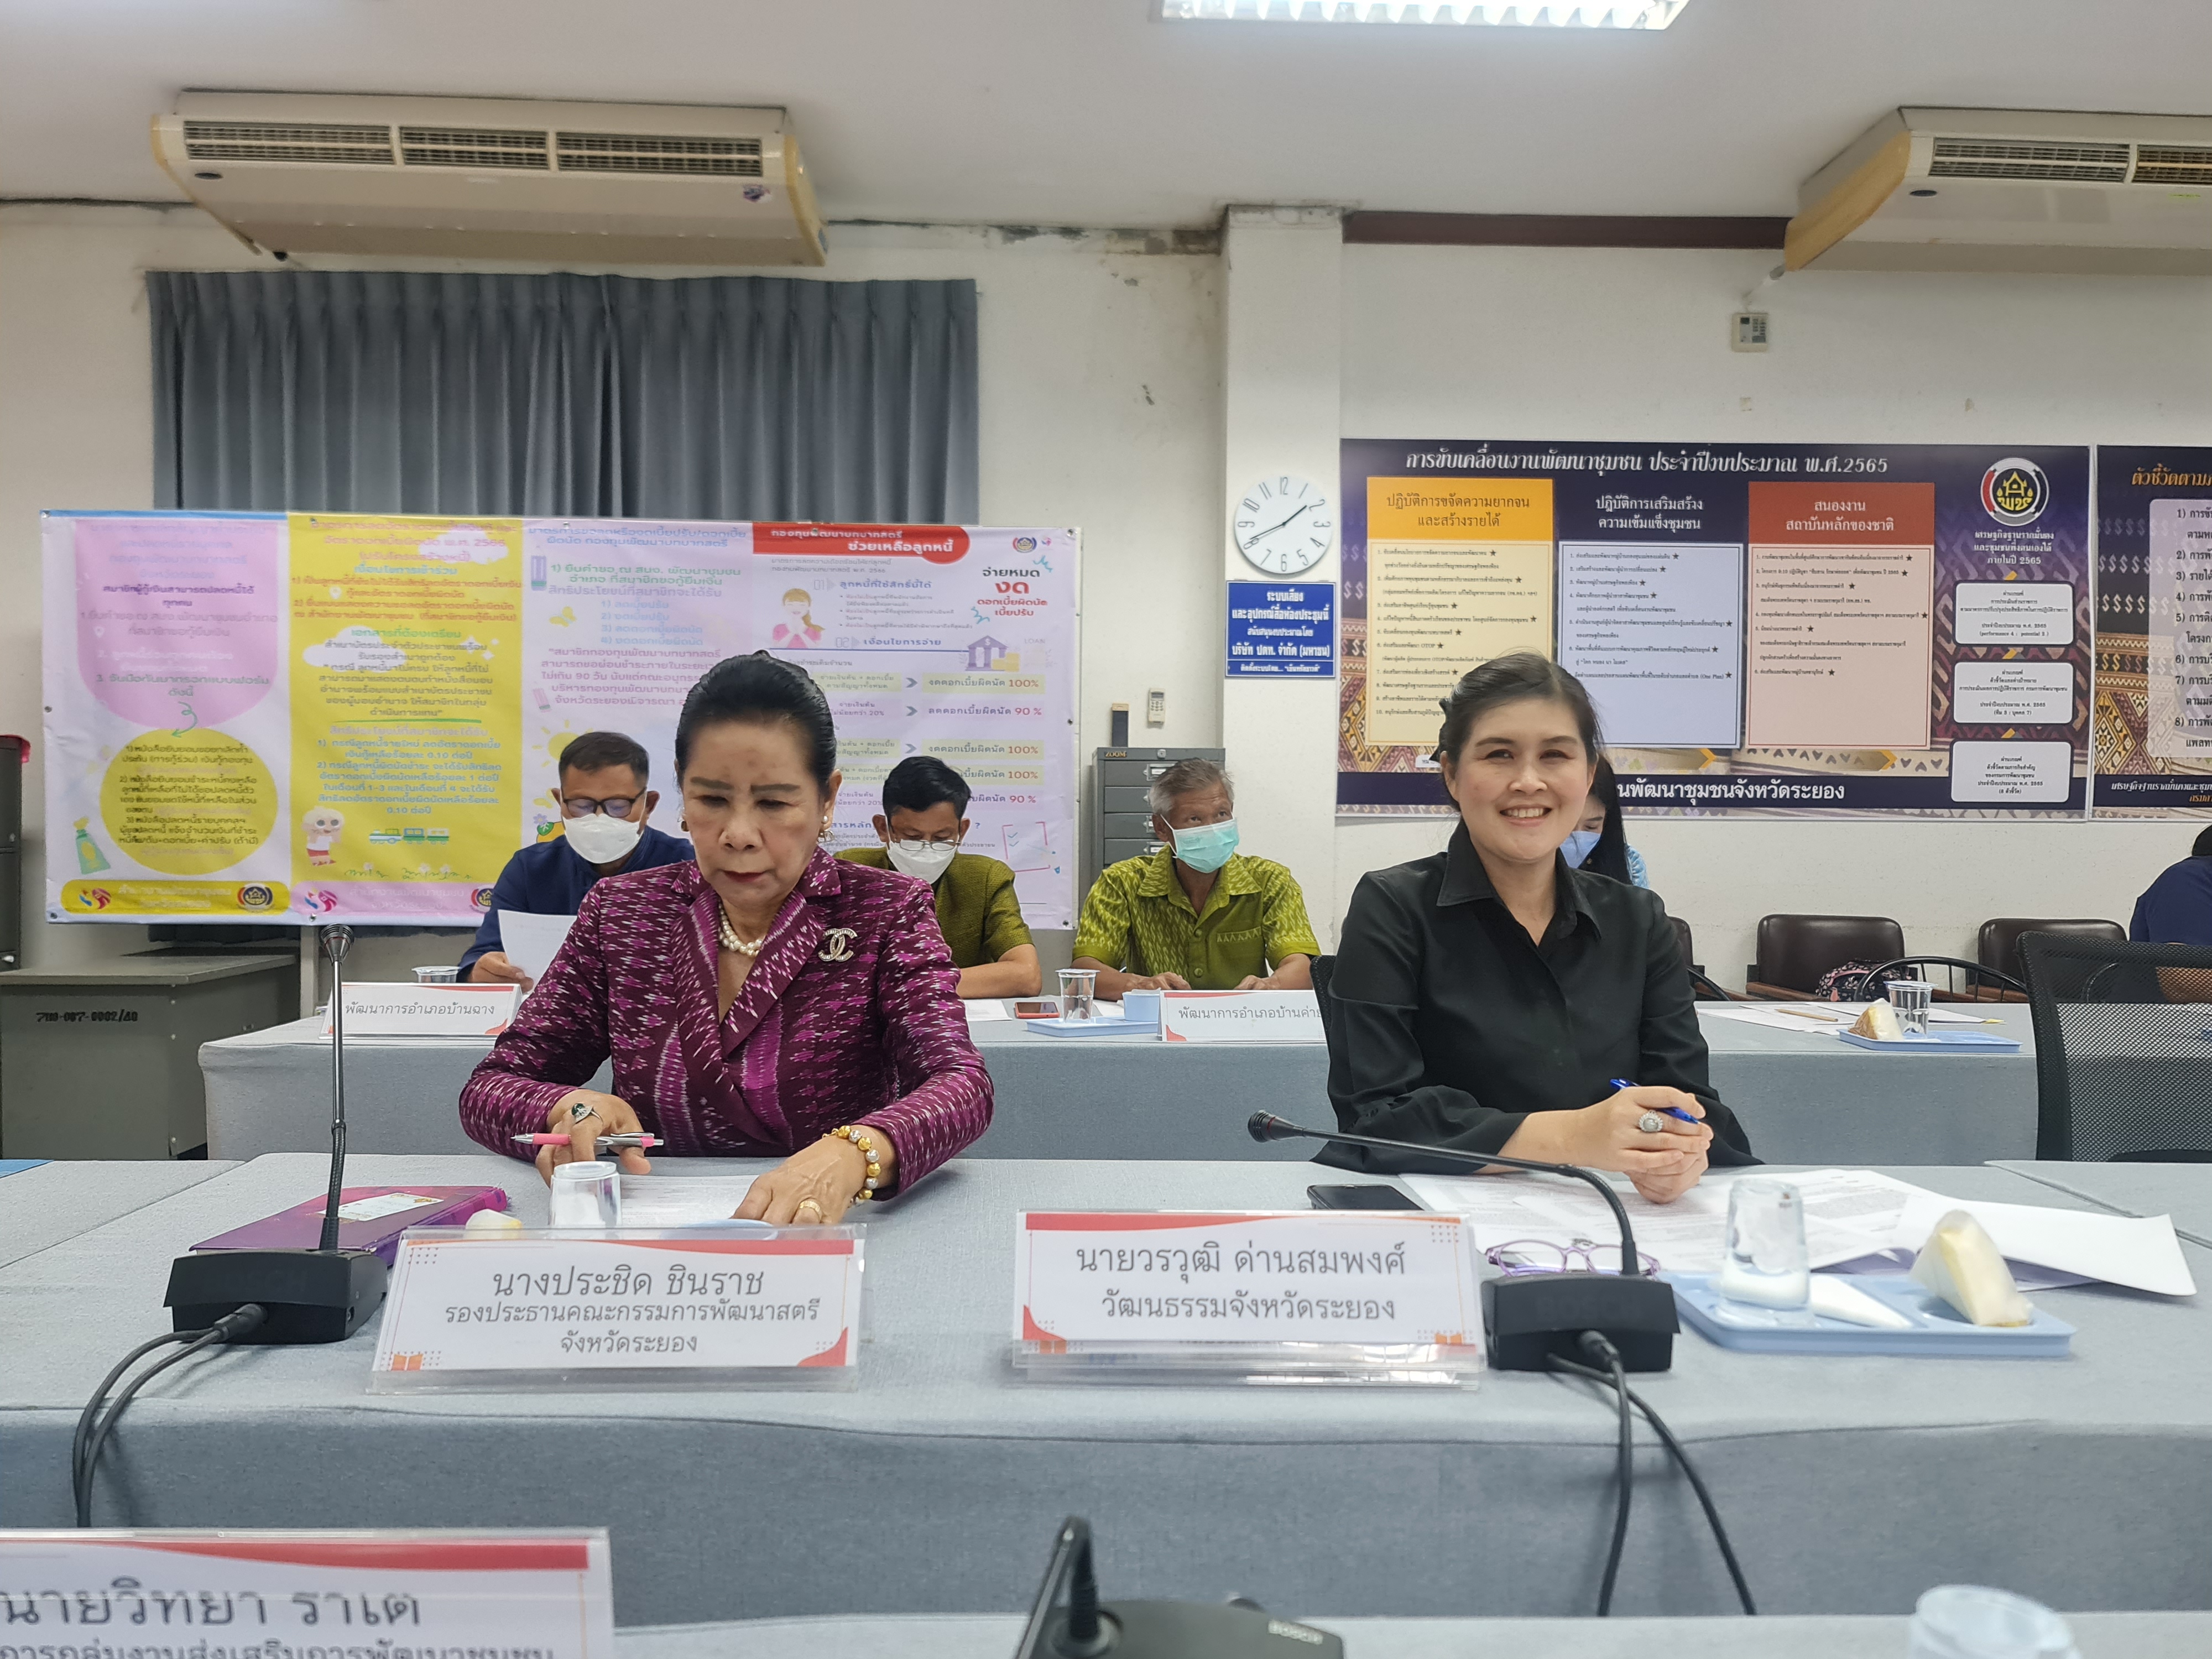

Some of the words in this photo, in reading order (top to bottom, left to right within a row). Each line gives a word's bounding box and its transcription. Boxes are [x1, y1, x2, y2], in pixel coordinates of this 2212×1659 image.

[1406, 444, 1643, 477] การขับเคลื่อนงานพัฒนาชุมชน
[1650, 449, 1798, 472] ประจำปีงบประมาณ
[1804, 455, 1888, 473] พ.ศ.2565
[1280, 477, 1288, 495] 12
[1243, 498, 1260, 513] 10
[1309, 499, 1325, 512] 2
[1387, 493, 1530, 510] ปฏิบัติการขจัดความยากจน
[1596, 494, 1703, 511] ปฏิบัติการเสริมสร้าง
[1814, 500, 1866, 513] สนองงาน
[1417, 512, 1500, 529] และสร้างรายได้
[1599, 515, 1700, 534] ความเข้มแข็งชุมชน
[1786, 516, 1895, 532] สถาบันหลักของชาติ
[848, 540, 954, 554] ช่วยเหลือลูกหนี้
[1244, 538, 1259, 549] 8
[1310, 538, 1325, 547] 4
[1261, 549, 1271, 565] 7
[1281, 554, 1287, 571] 6
[1297, 549, 1308, 566] 5
[668, 565, 741, 578] พัฒนาชุมชน
[982, 566, 1040, 577] จ่ายหมด
[995, 581, 1030, 594] งด
[1267, 588, 1304, 602] ระบบเสียง
[977, 596, 1048, 606] ดอกเบี้ยผิดนัด
[995, 606, 1034, 617] เบี้ยปรับ
[863, 635, 942, 646] เงื่อนไขการจ่าย
[1232, 642, 1253, 655] บริษัท
[1256, 645, 1276, 655] ปตท.
[1278, 642, 1297, 656] จำกัด
[1300, 645, 1330, 658] (มหาชน)
[928, 677, 1005, 687] งดดอกเบี้ยผิดนัด
[1009, 679, 1039, 688] 100%
[928, 705, 1011, 716] ลดดอกเบี้ยผิดนัด
[1015, 707, 1030, 716] 90
[1032, 708, 1042, 716] %
[928, 742, 1005, 753] งดดอกเบี้ยผิดนัด
[1008, 745, 1039, 754] 100%
[1008, 771, 1039, 779] 100%
[346, 1001, 494, 1015] พัฒนาการอำเภอบ้านฉาง
[1076, 1241, 1221, 1283] นายวรวุฒิ
[1234, 1241, 1406, 1275] ด่านสมพงศ์
[493, 1264, 652, 1296] นางประชิด
[667, 1265, 764, 1296] ชินราช
[445, 1297, 820, 1323] รองประธานคณะกรรมการพัฒนาสตรี
[1102, 1288, 1395, 1321] วัฒนธรรมจังหวัดระยอง
[560, 1329, 698, 1354] จังหวัดระยอง
[2, 1575, 268, 1625] นายวิทยา
[292, 1592, 420, 1626] ราเต
